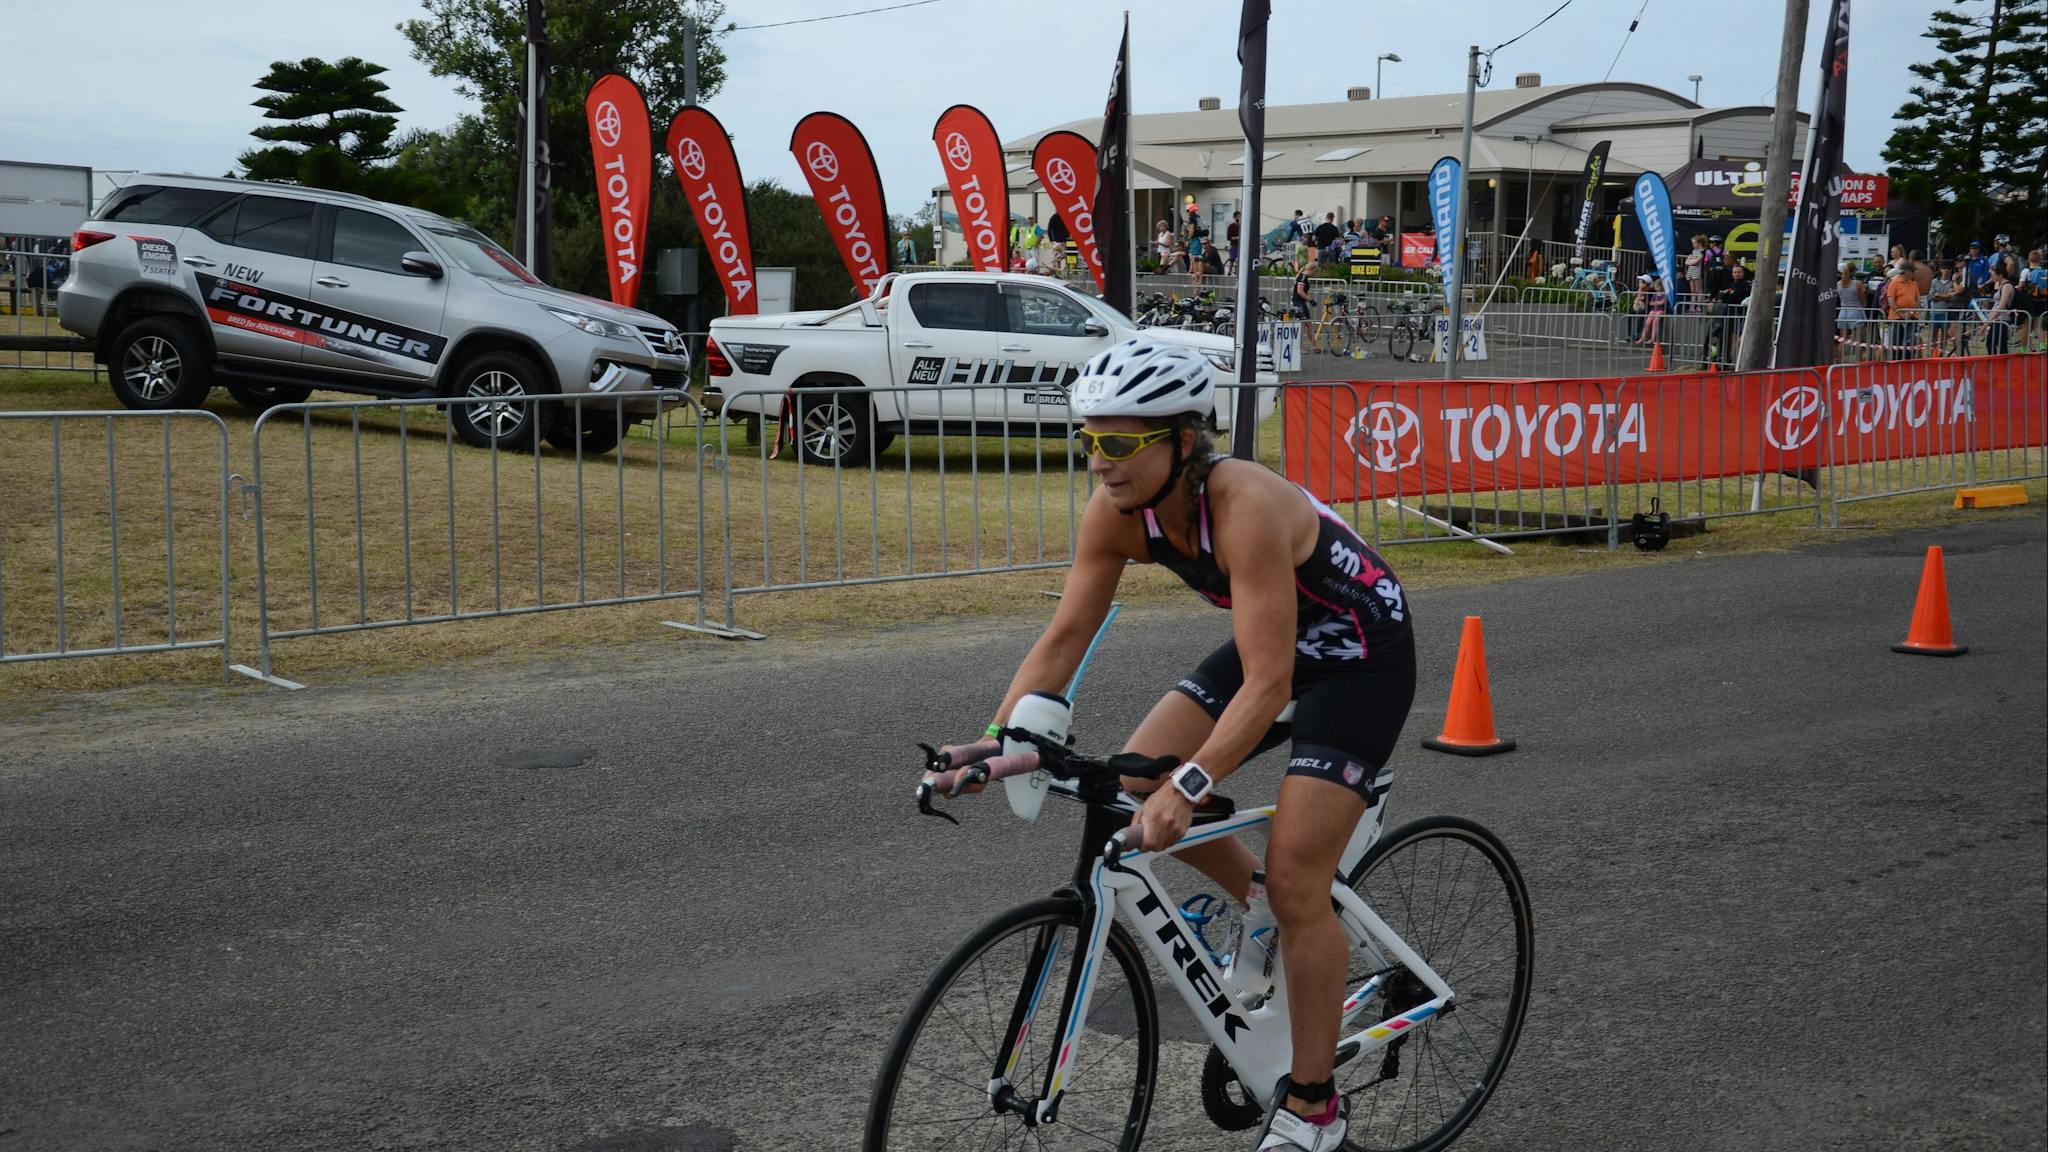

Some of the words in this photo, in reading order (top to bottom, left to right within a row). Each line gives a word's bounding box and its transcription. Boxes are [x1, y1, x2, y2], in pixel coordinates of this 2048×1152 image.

[604, 154, 638, 284] TOYOTA
[961, 174, 1003, 272] TOYOT
[697, 183, 752, 302] TOYOTA
[1638, 179, 1674, 295] SHIMANO
[141, 243, 170, 253] DIESEL
[142, 252, 174, 261] ENGINE
[143, 265, 149, 273] 7
[150, 267, 176, 275] SEATER
[223, 262, 265, 283] NEW
[1366, 264, 1380, 275] EXIT
[228, 281, 259, 296] TOYOTA
[209, 286, 431, 358] FORTUNER
[227, 315, 245, 325] BRED
[245, 319, 256, 329] for
[256, 322, 297, 338] ADVENTURE
[1438, 320, 1449, 332] RO
[1277, 327, 1299, 340] ROW
[1470, 335, 1478, 352] 2
[1283, 344, 1293, 363] 4
[915, 359, 941, 370] ALL-
[911, 370, 939, 382] NEW
[1088, 380, 1105, 394] 61
[1837, 377, 1976, 436] TOYOTA
[1440, 402, 1648, 463] TOYOTA
[1136, 893, 1252, 1044] TREK
